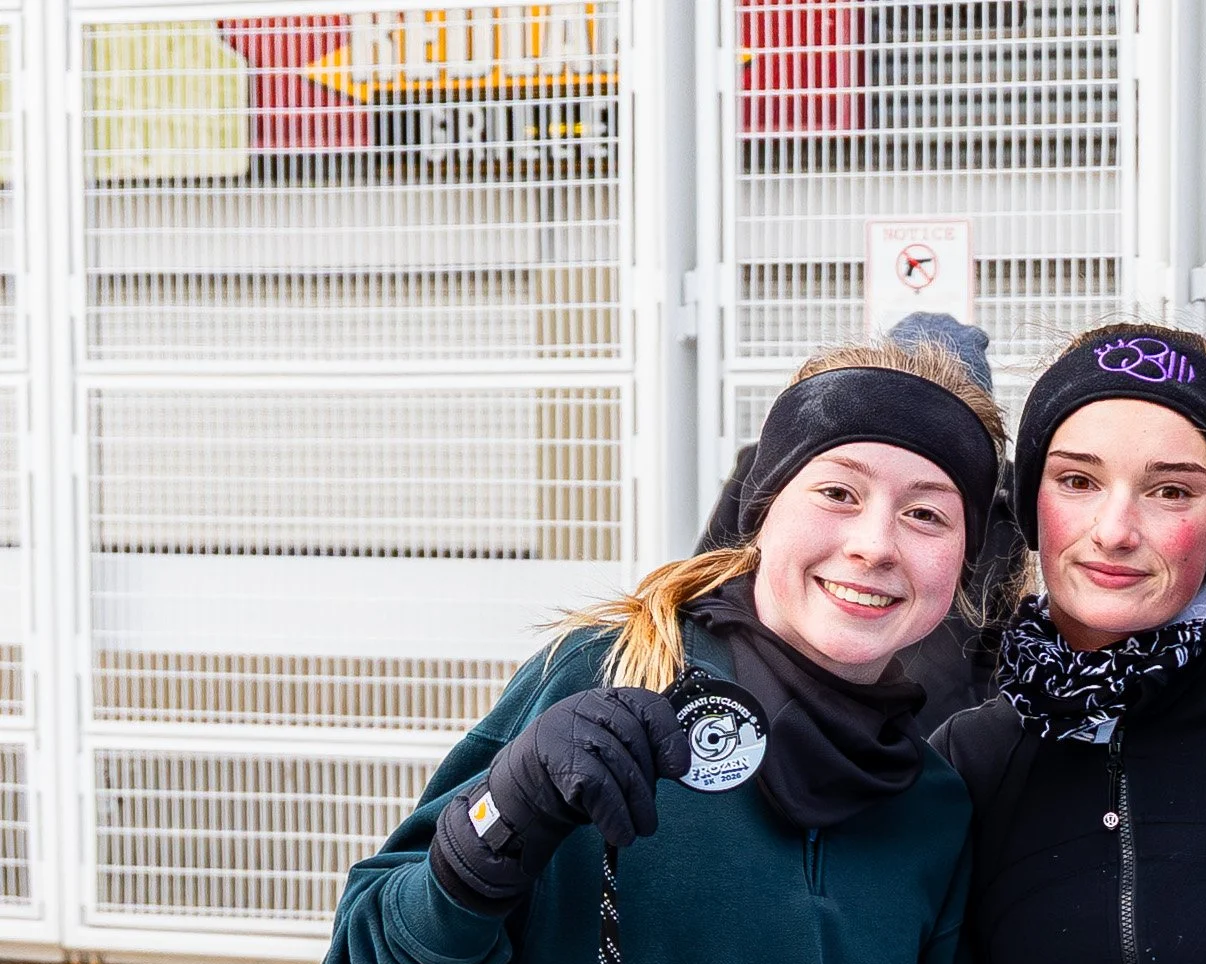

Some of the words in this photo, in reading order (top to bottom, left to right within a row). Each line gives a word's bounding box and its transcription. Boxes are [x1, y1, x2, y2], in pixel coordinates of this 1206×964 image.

[883, 227, 956, 241] NOTICE
[691, 757, 750, 782] FROZEN
[721, 773, 742, 782] 2026
